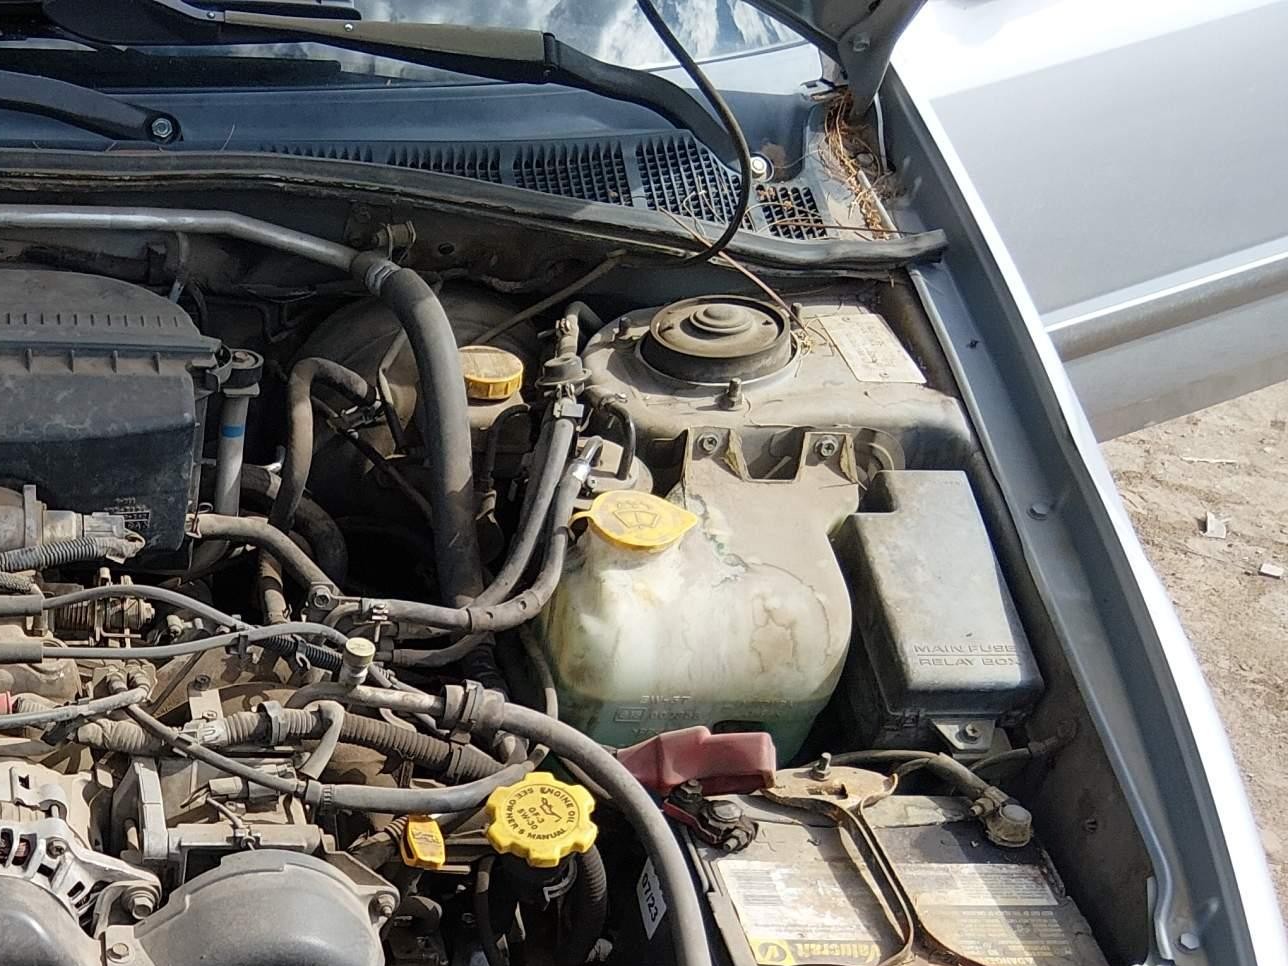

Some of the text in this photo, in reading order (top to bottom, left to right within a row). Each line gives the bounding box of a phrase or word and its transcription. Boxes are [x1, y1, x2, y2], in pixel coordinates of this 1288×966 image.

[913, 644, 1017, 653] MAIN FUSE
[918, 657, 1022, 666] RELAY BOX
[514, 787, 534, 800] SEE
[526, 827, 567, 840] MANUAL
[539, 786, 576, 823] ENGINE OIL
[642, 872, 658, 922] 07/23
